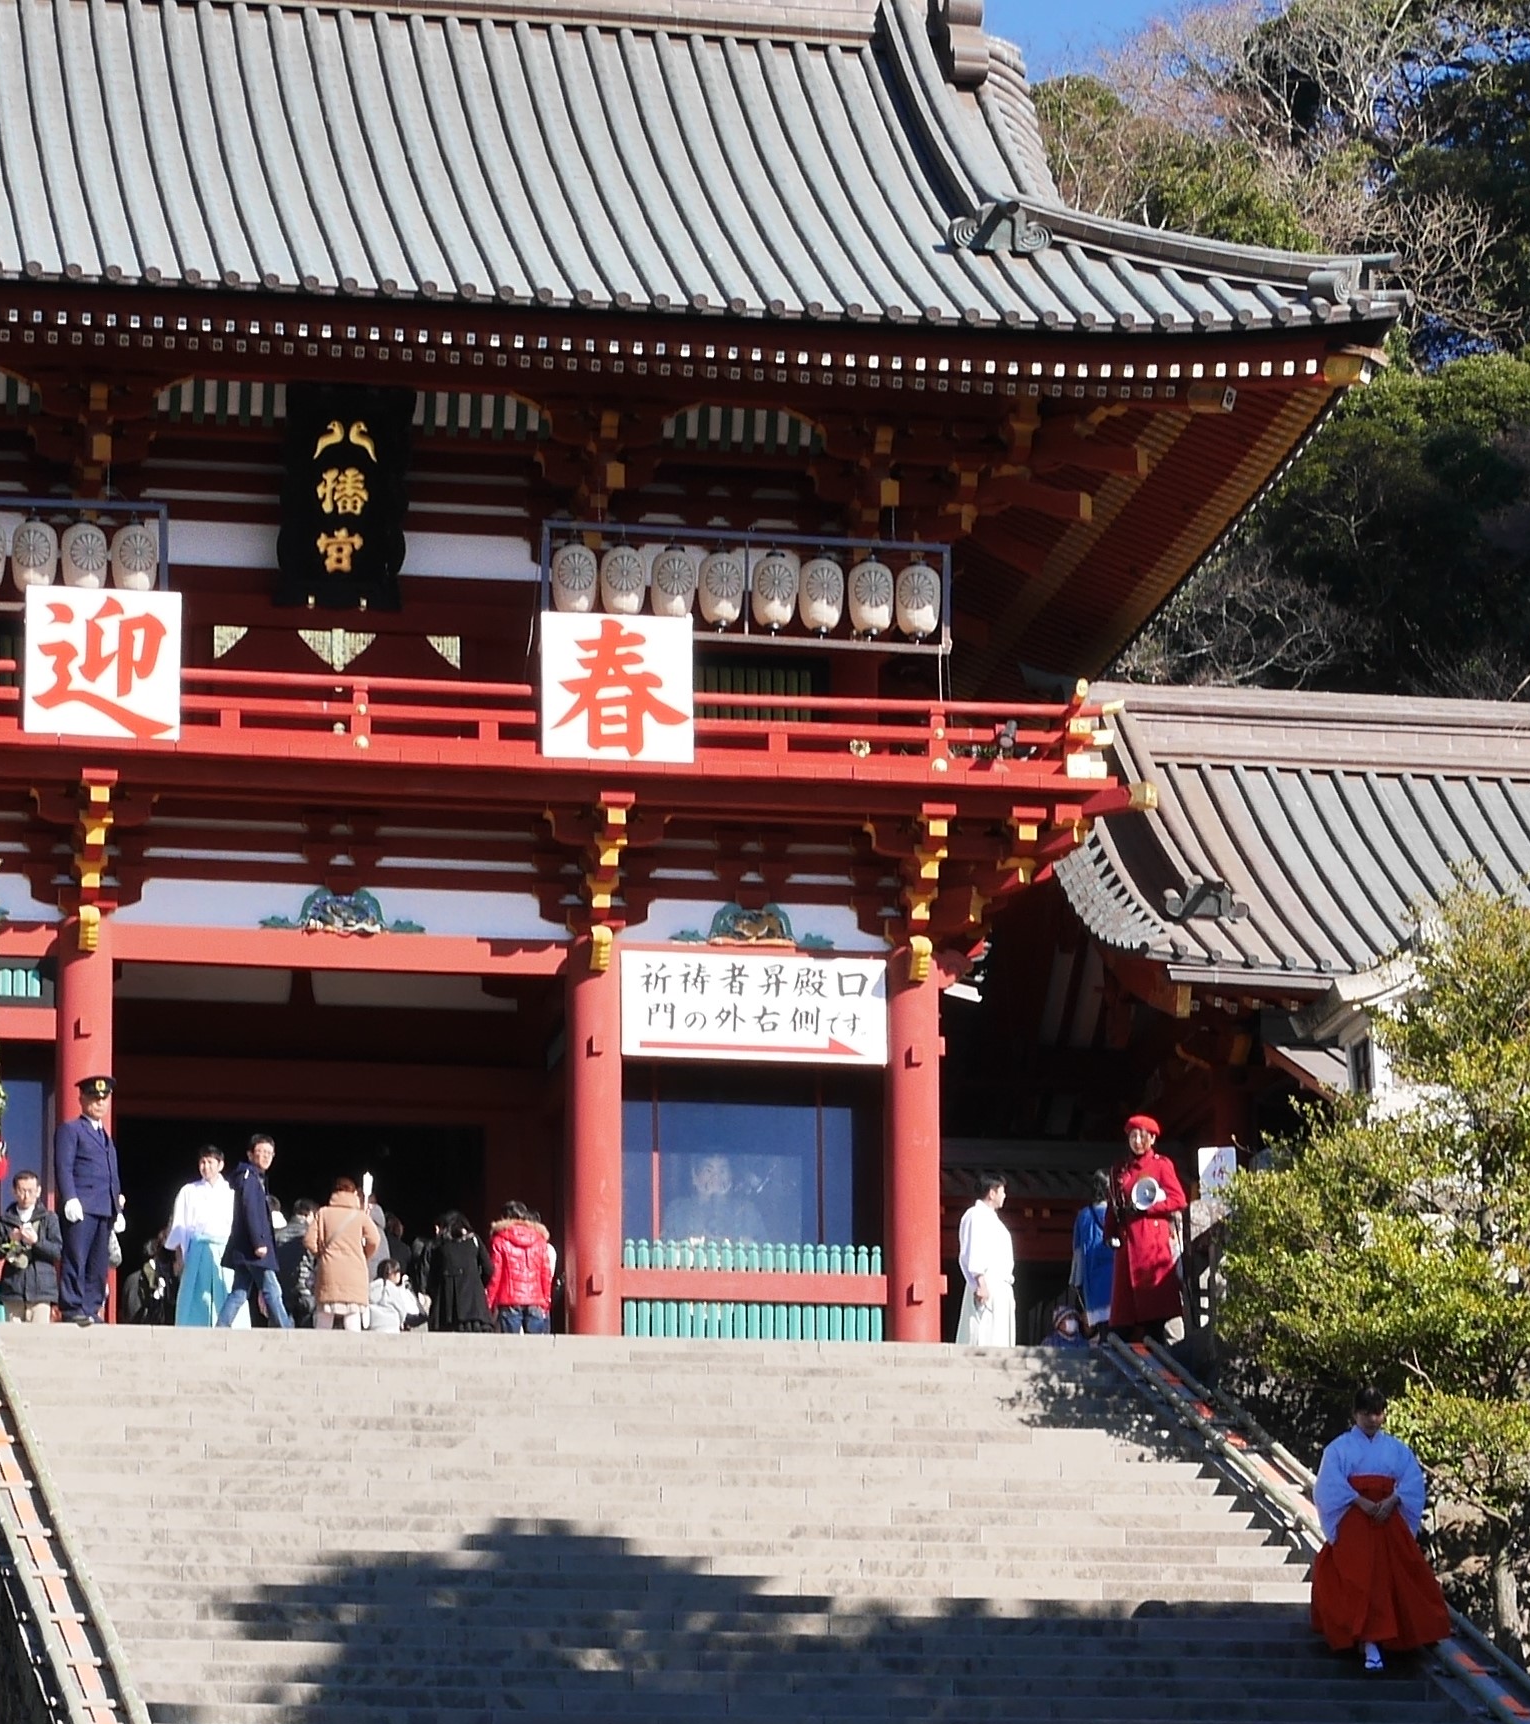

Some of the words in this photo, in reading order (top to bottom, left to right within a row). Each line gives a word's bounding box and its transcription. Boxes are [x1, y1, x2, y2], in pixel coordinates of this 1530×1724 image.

[313, 419, 378, 574] 八幡宮
[31, 596, 175, 739] 迎
[550, 619, 690, 757] 春
